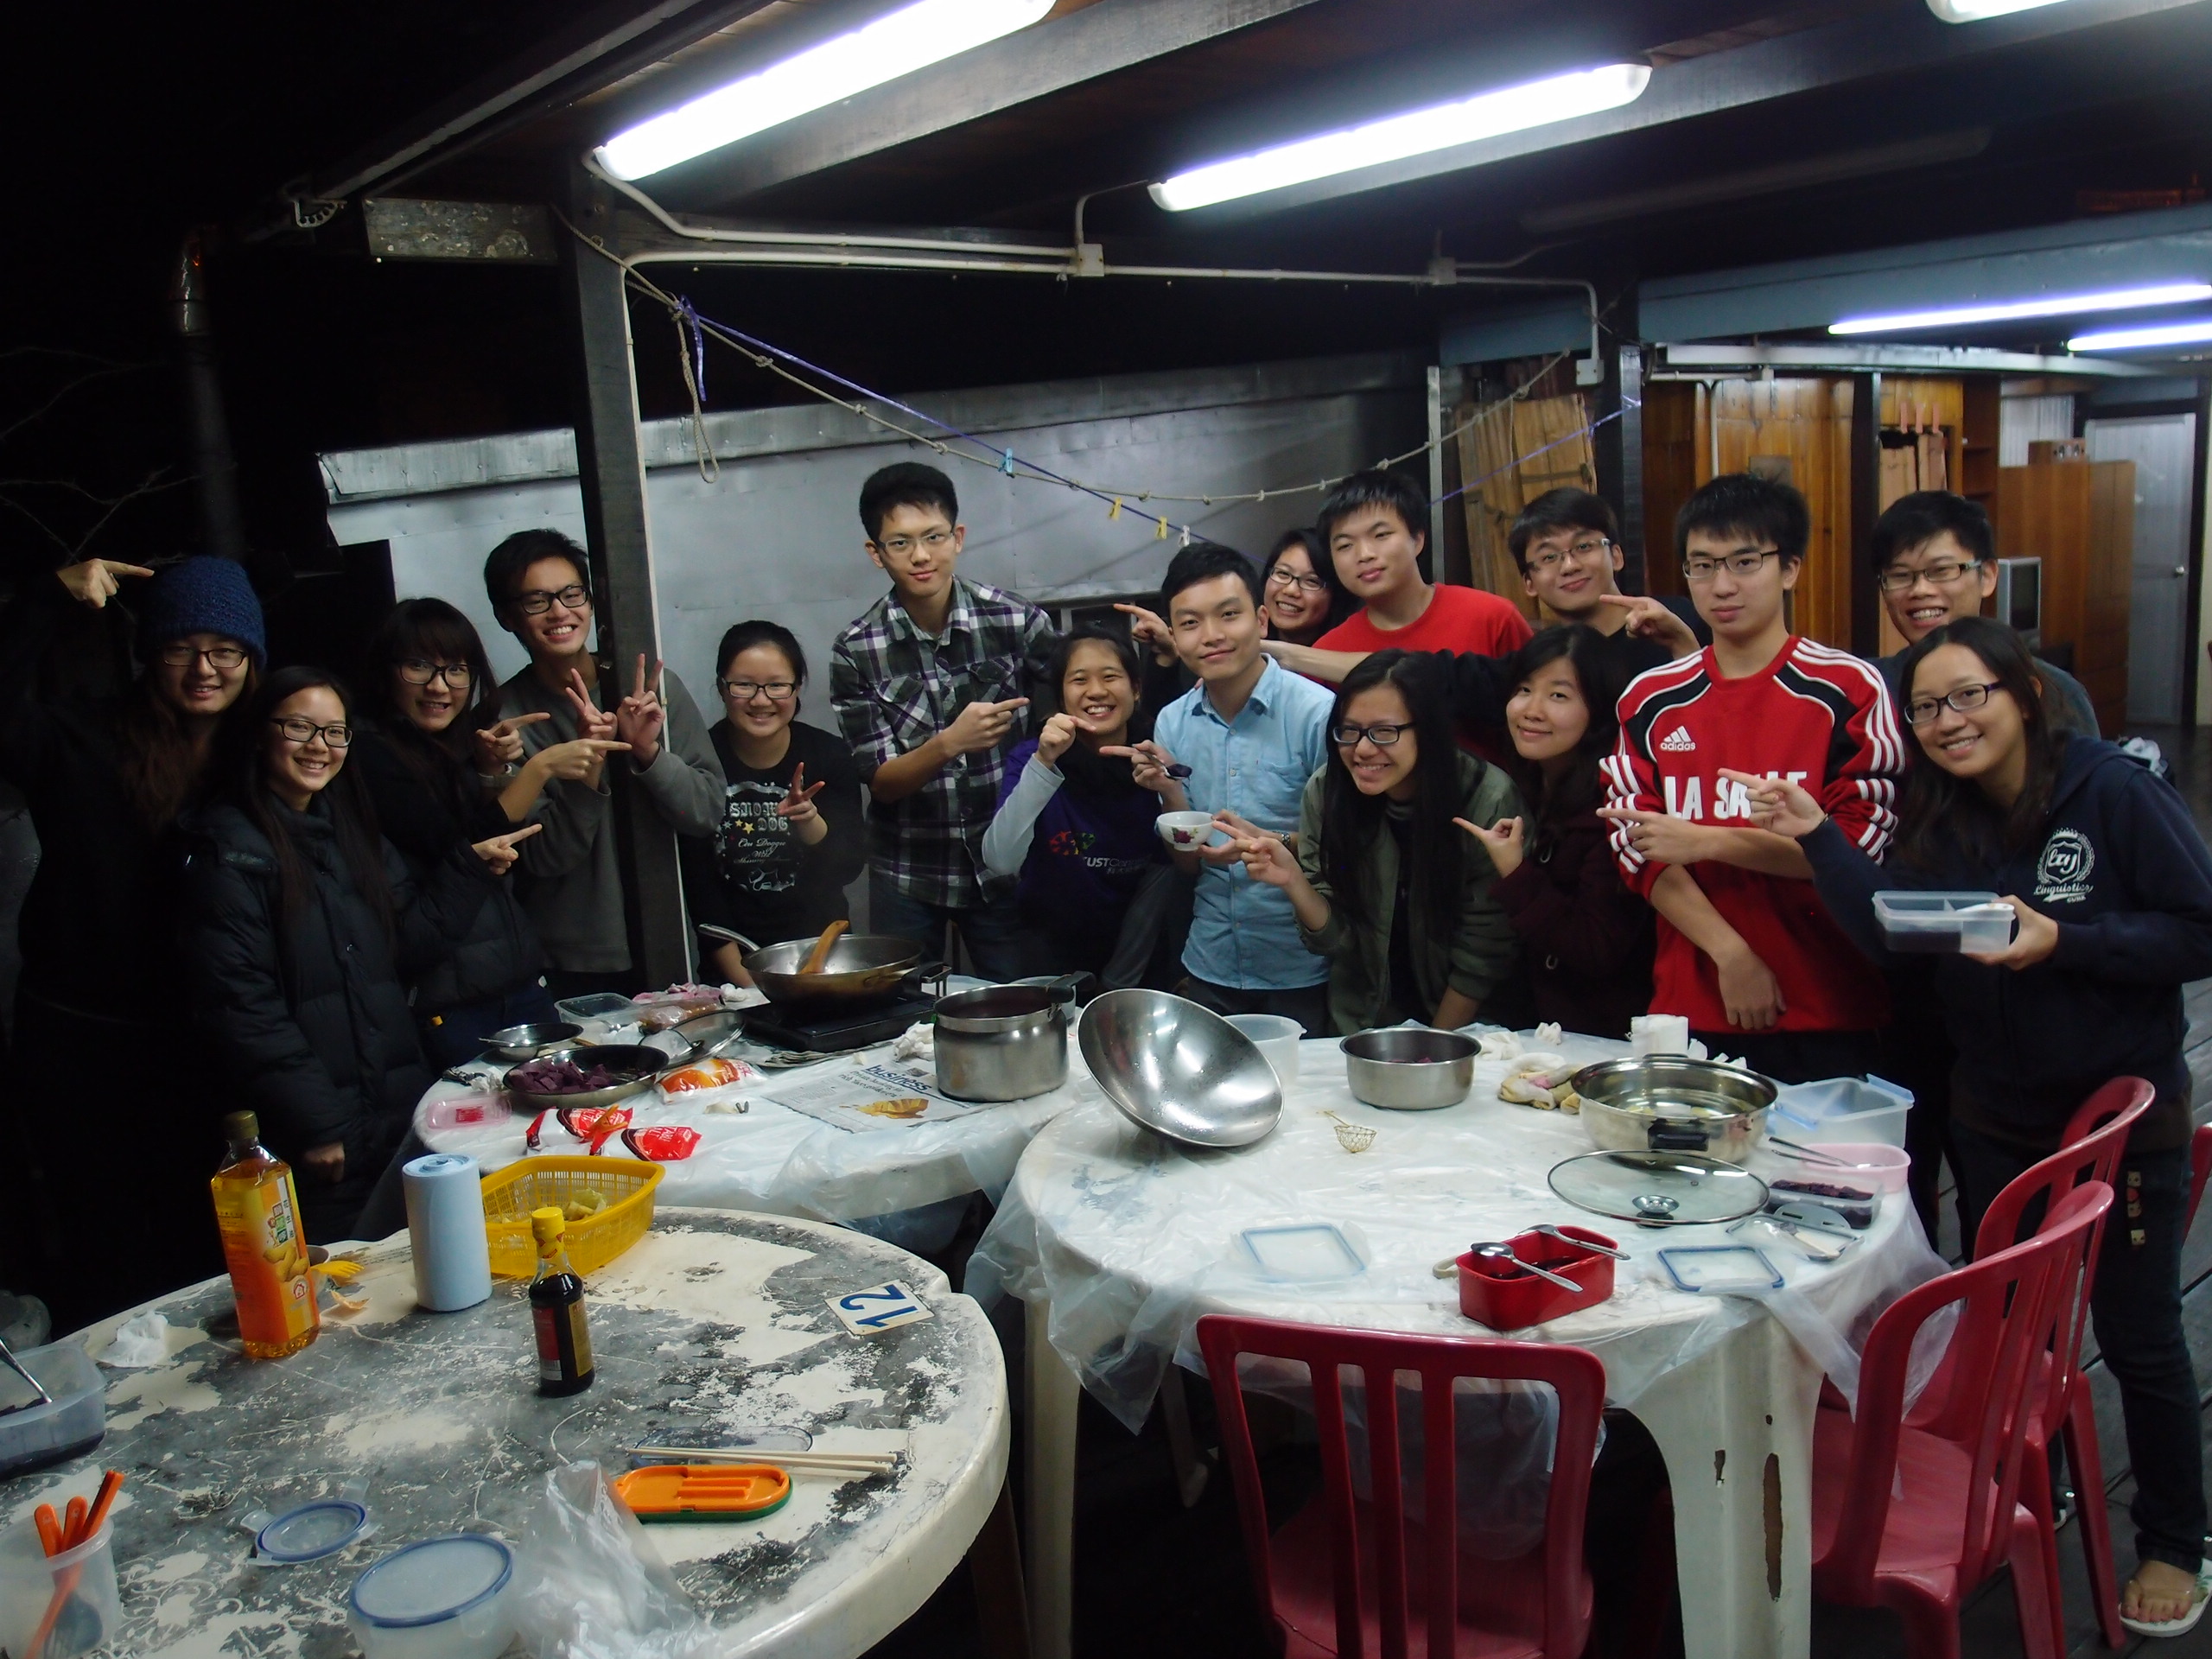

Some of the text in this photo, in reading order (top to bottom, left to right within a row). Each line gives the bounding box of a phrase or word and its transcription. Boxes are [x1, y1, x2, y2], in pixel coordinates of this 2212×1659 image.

[1660, 741, 1696, 751] adidas
[1664, 776, 1704, 820] LA
[2033, 882, 2094, 895] Linguistics
[865, 1064, 932, 1091] business
[839, 1283, 918, 1328] 12
